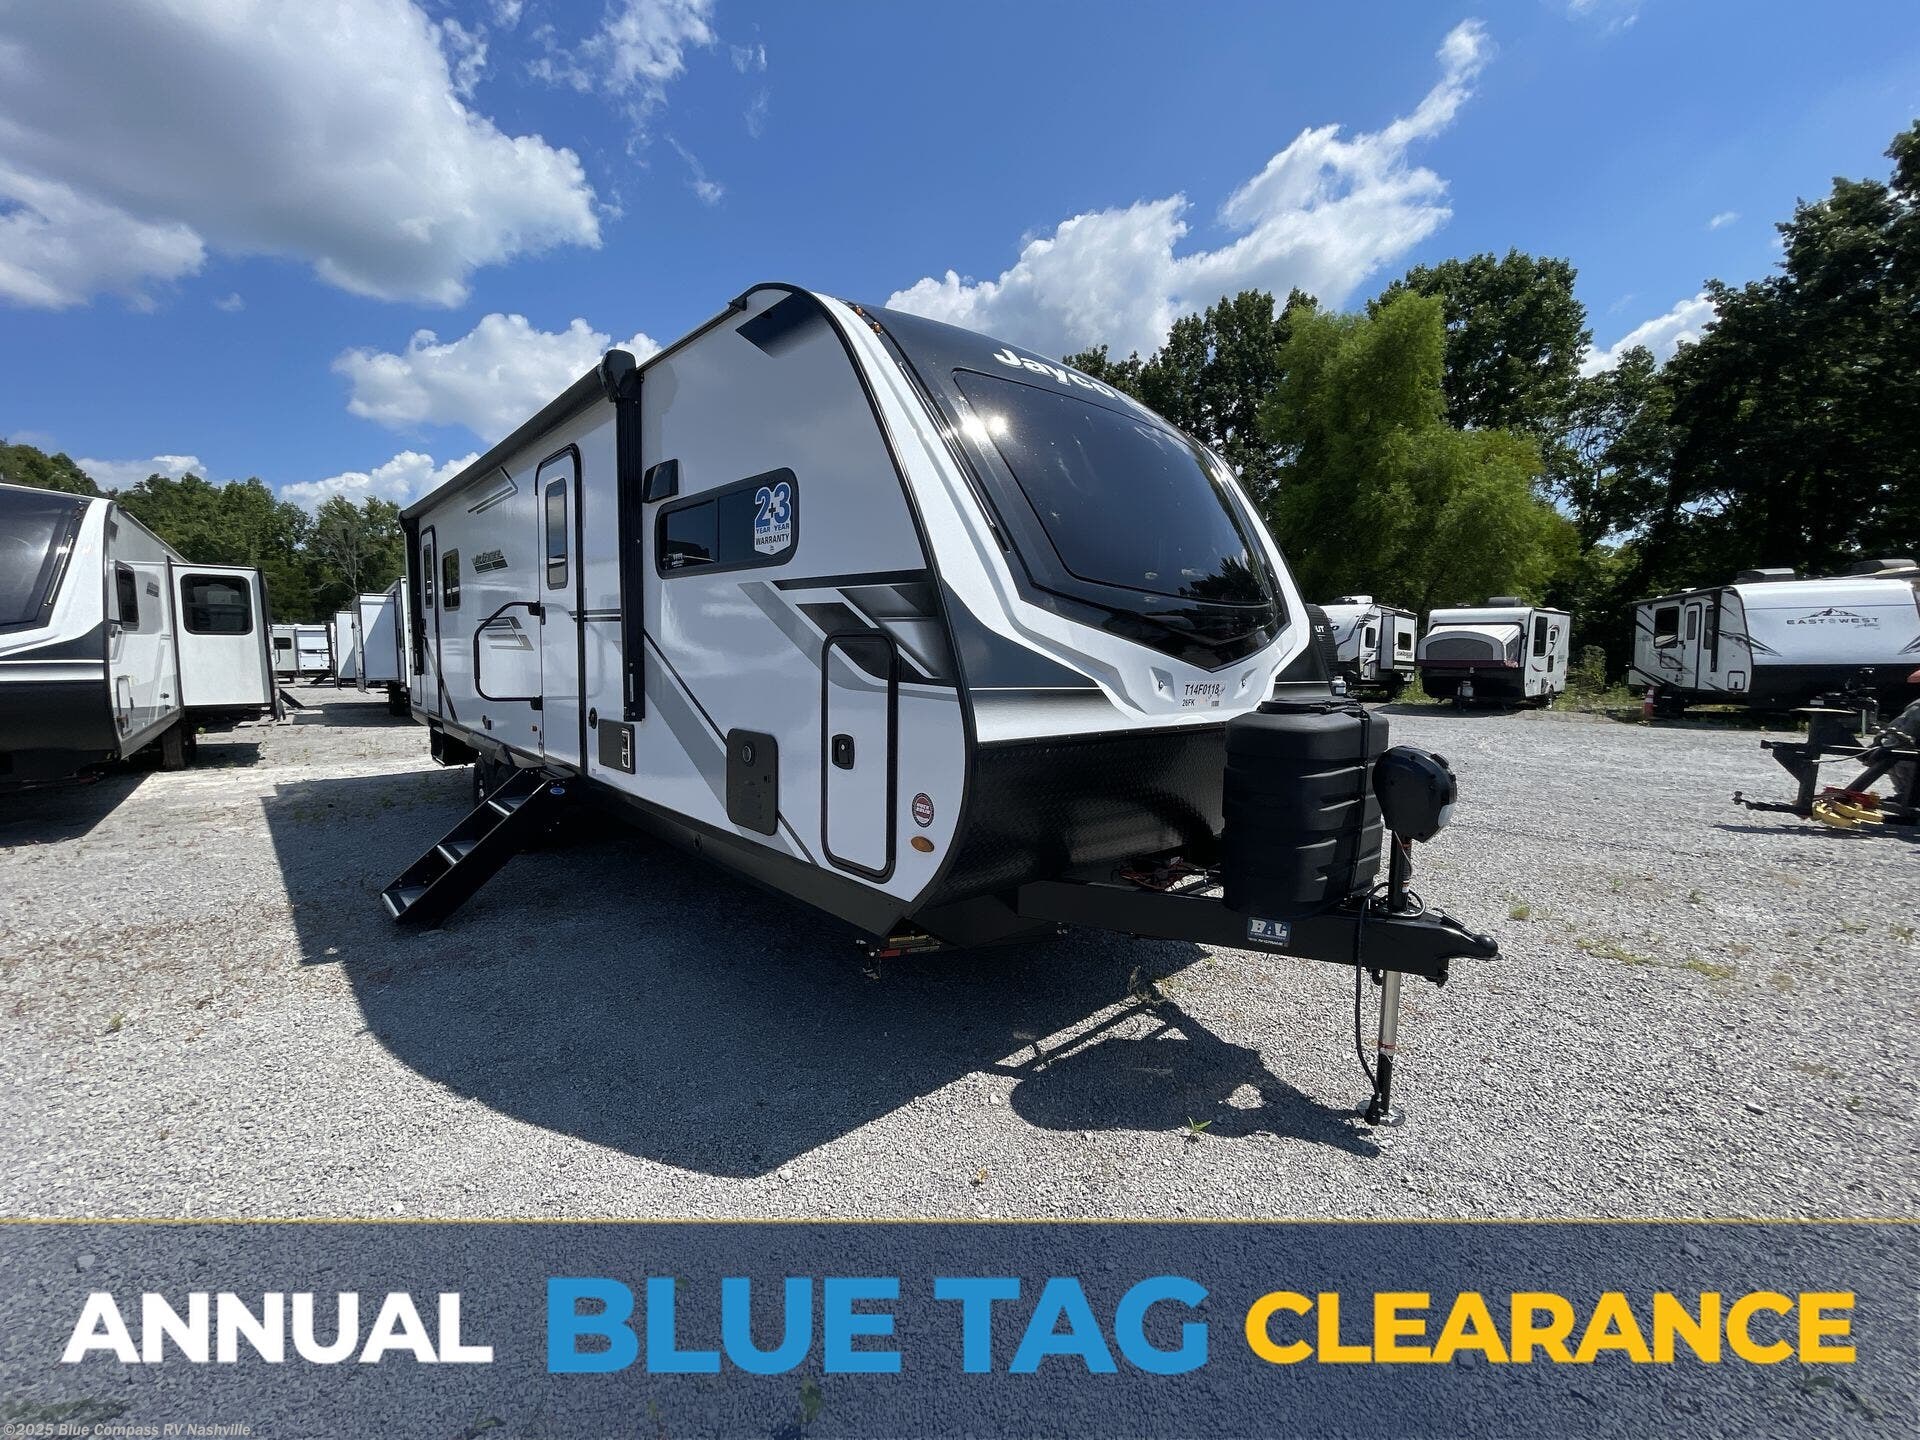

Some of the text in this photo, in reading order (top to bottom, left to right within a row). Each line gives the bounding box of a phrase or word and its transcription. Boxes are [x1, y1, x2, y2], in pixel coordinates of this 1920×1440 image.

[993, 348, 1118, 400] Jayco
[774, 523, 790, 531] YEAR
[756, 533, 790, 545] WARRANTY
